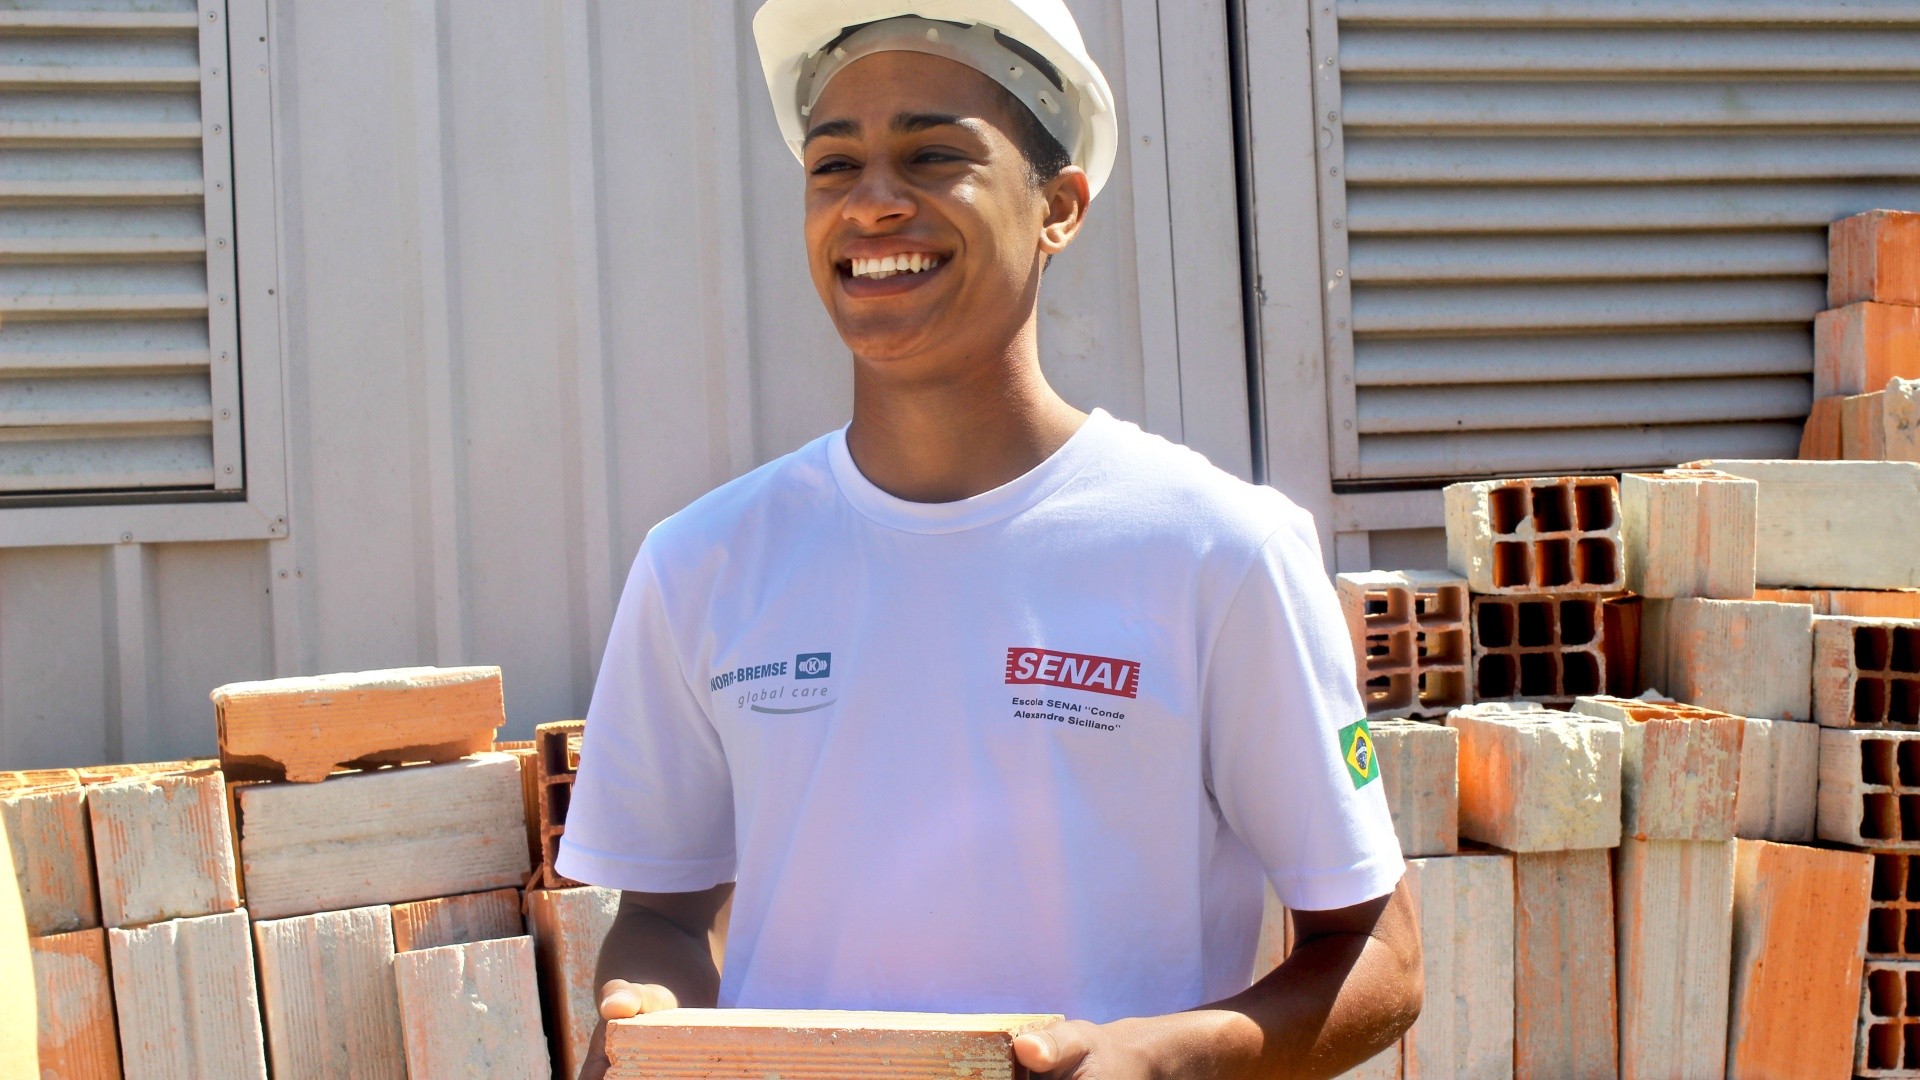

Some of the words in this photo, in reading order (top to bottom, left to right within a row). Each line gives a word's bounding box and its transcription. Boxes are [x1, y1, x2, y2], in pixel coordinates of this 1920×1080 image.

[1014, 652, 1130, 691] SENAI
[738, 686, 785, 709] global
[791, 686, 828, 698] care
[1012, 697, 1044, 706] Escola
[1046, 699, 1082, 713] SENAI
[1013, 710, 1065, 723] Alexandre
